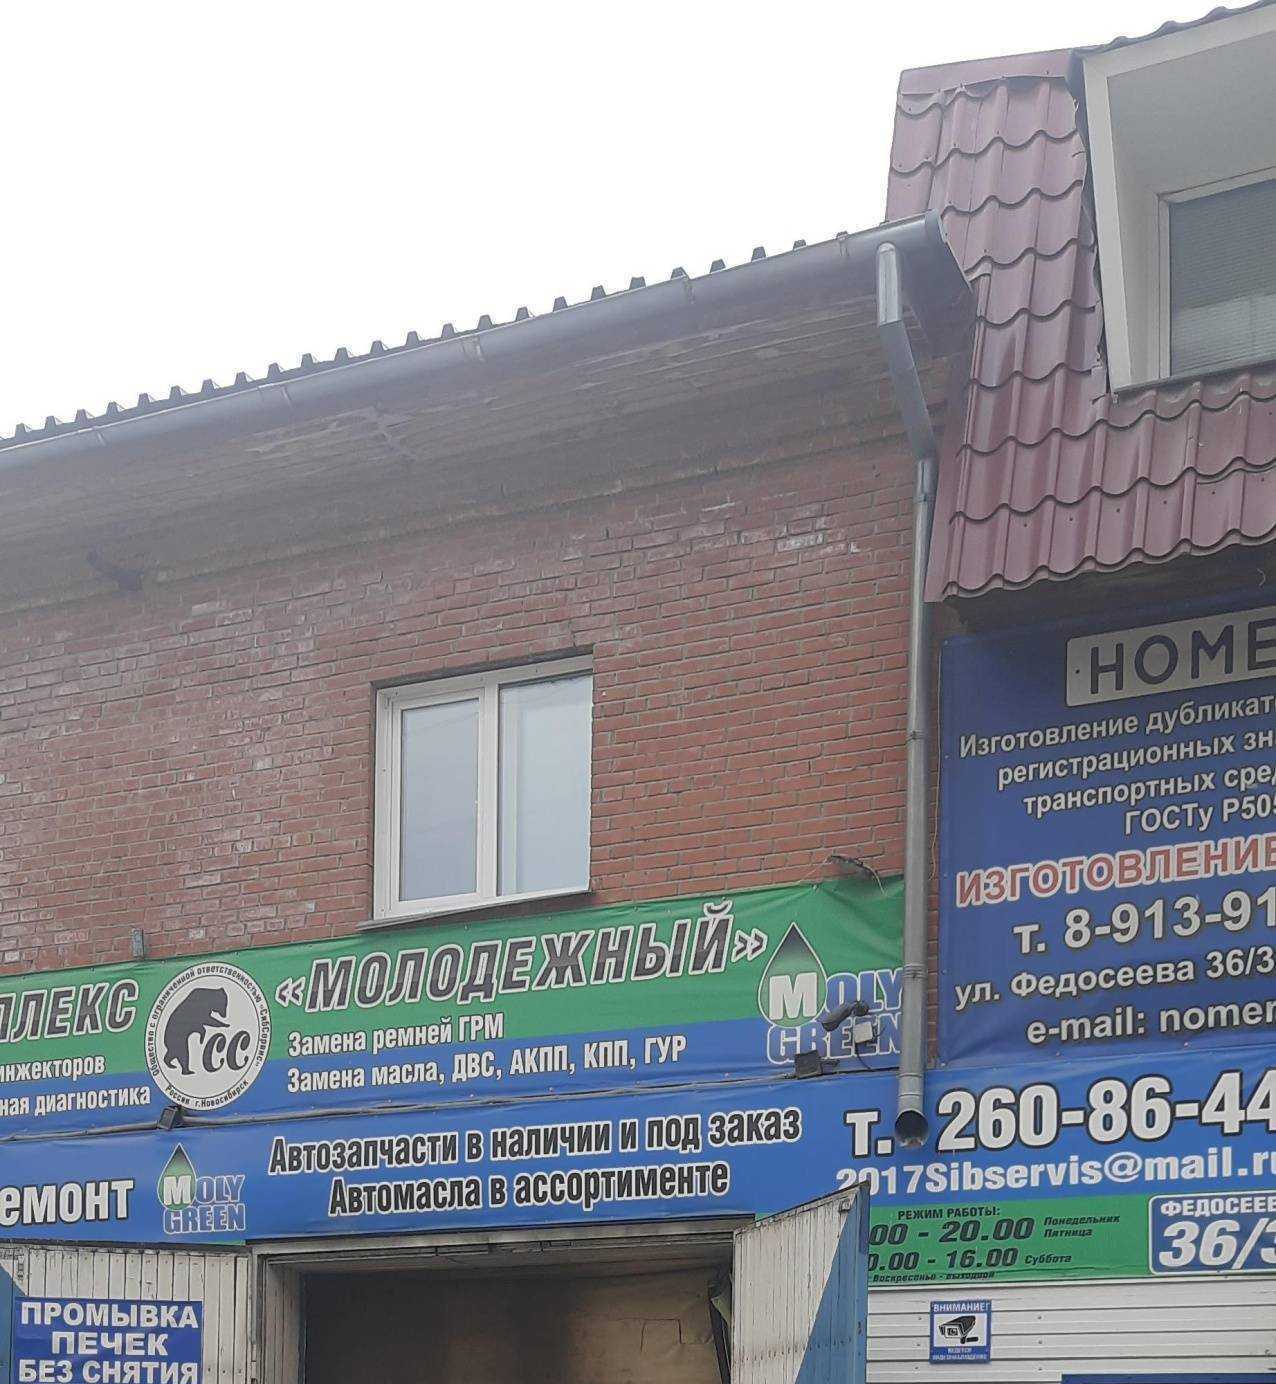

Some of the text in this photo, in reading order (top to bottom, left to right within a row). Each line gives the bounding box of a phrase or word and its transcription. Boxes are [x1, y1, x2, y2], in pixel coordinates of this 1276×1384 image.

[959, 715, 1138, 759] Изготовление
[997, 734, 1234, 790] регистрационных
[1023, 764, 1276, 819] транспортных сре
[1124, 794, 1276, 836] ГОСТу Р50
[1064, 887, 1276, 949] 8-913-91
[275, 900, 768, 1013] «МОЛОДЕЖНЫЙ»
[955, 946, 1275, 1011] ул. Федосеева 36/3
[288, 1013, 505, 1057] Замена ремней ГРМ
[1027, 1006, 1146, 1045] e-mail:
[287, 1035, 688, 1093] Замена масла, ДВС, АКПП, КПП, ГУР
[34, 1086, 151, 1117] диагностика
[936, 1067, 1276, 1153] 260-86-44
[268, 1106, 802, 1175] Автозапчасти в наличии и под заказ
[328, 1161, 730, 1217] Автомасла в ассортименте
[163, 1203, 246, 1234] GREEN
[897, 1205, 1001, 1221] РЕЖИМ РАБОТЫ:
[938, 1217, 1036, 1243] 20.00
[1043, 1227, 1093, 1239] Пятница
[945, 1247, 1019, 1269] 16.00
[1024, 1253, 1073, 1266] Суббота
[19, 1302, 199, 1330] ПРОМЫВКА
[51, 1332, 169, 1356] ПЕЧЕК
[18, 1359, 199, 1384] БЕЗ СНЯТИЯ
